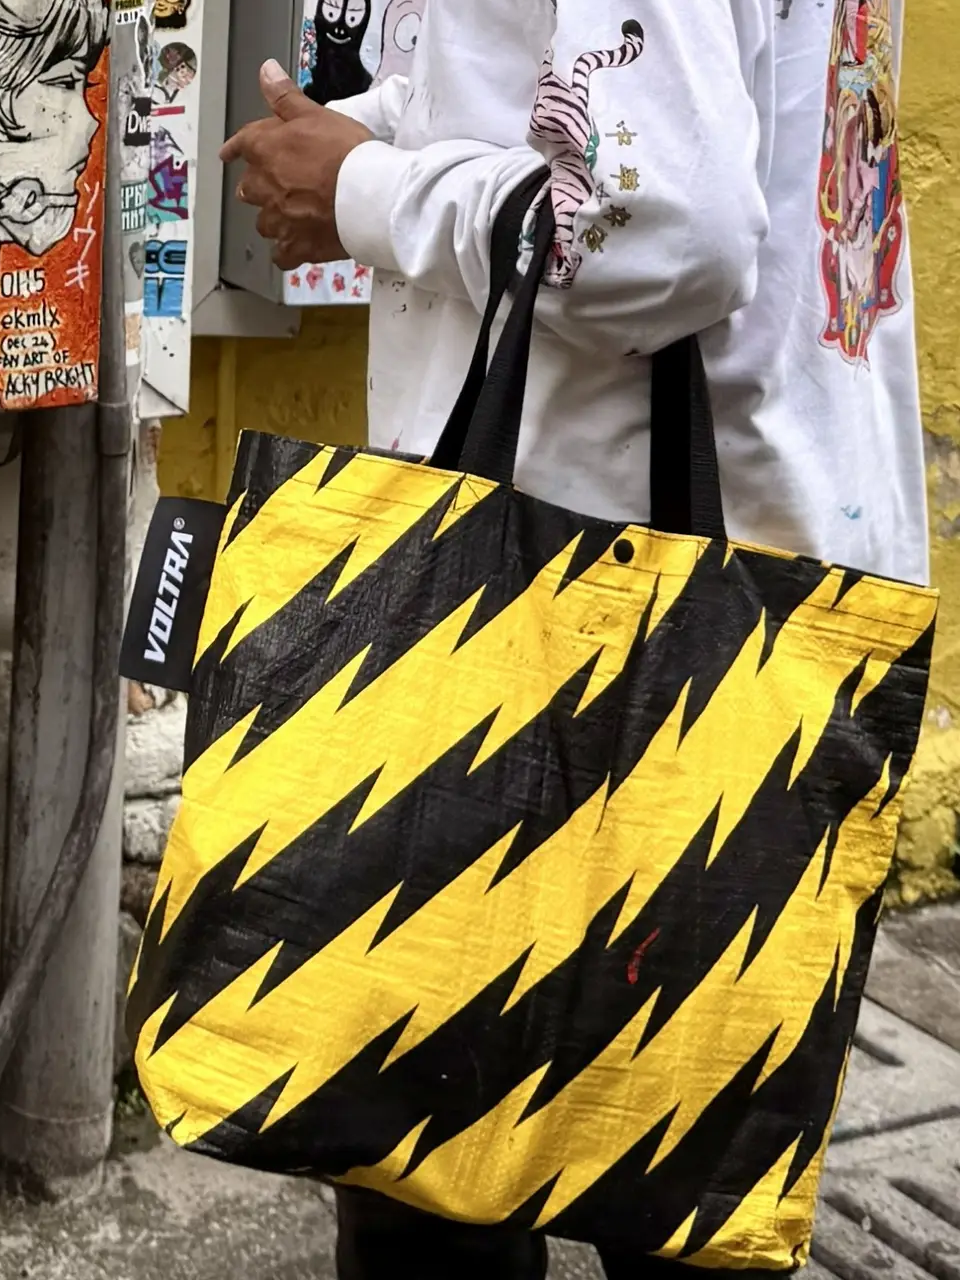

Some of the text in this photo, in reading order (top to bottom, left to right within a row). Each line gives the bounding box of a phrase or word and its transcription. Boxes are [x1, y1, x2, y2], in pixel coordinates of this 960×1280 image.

[23, 351, 48, 366] ART
[53, 350, 70, 363] OF
[5, 362, 95, 400] ACKY BRIGHT
[143, 530, 194, 663] VOLTRA
